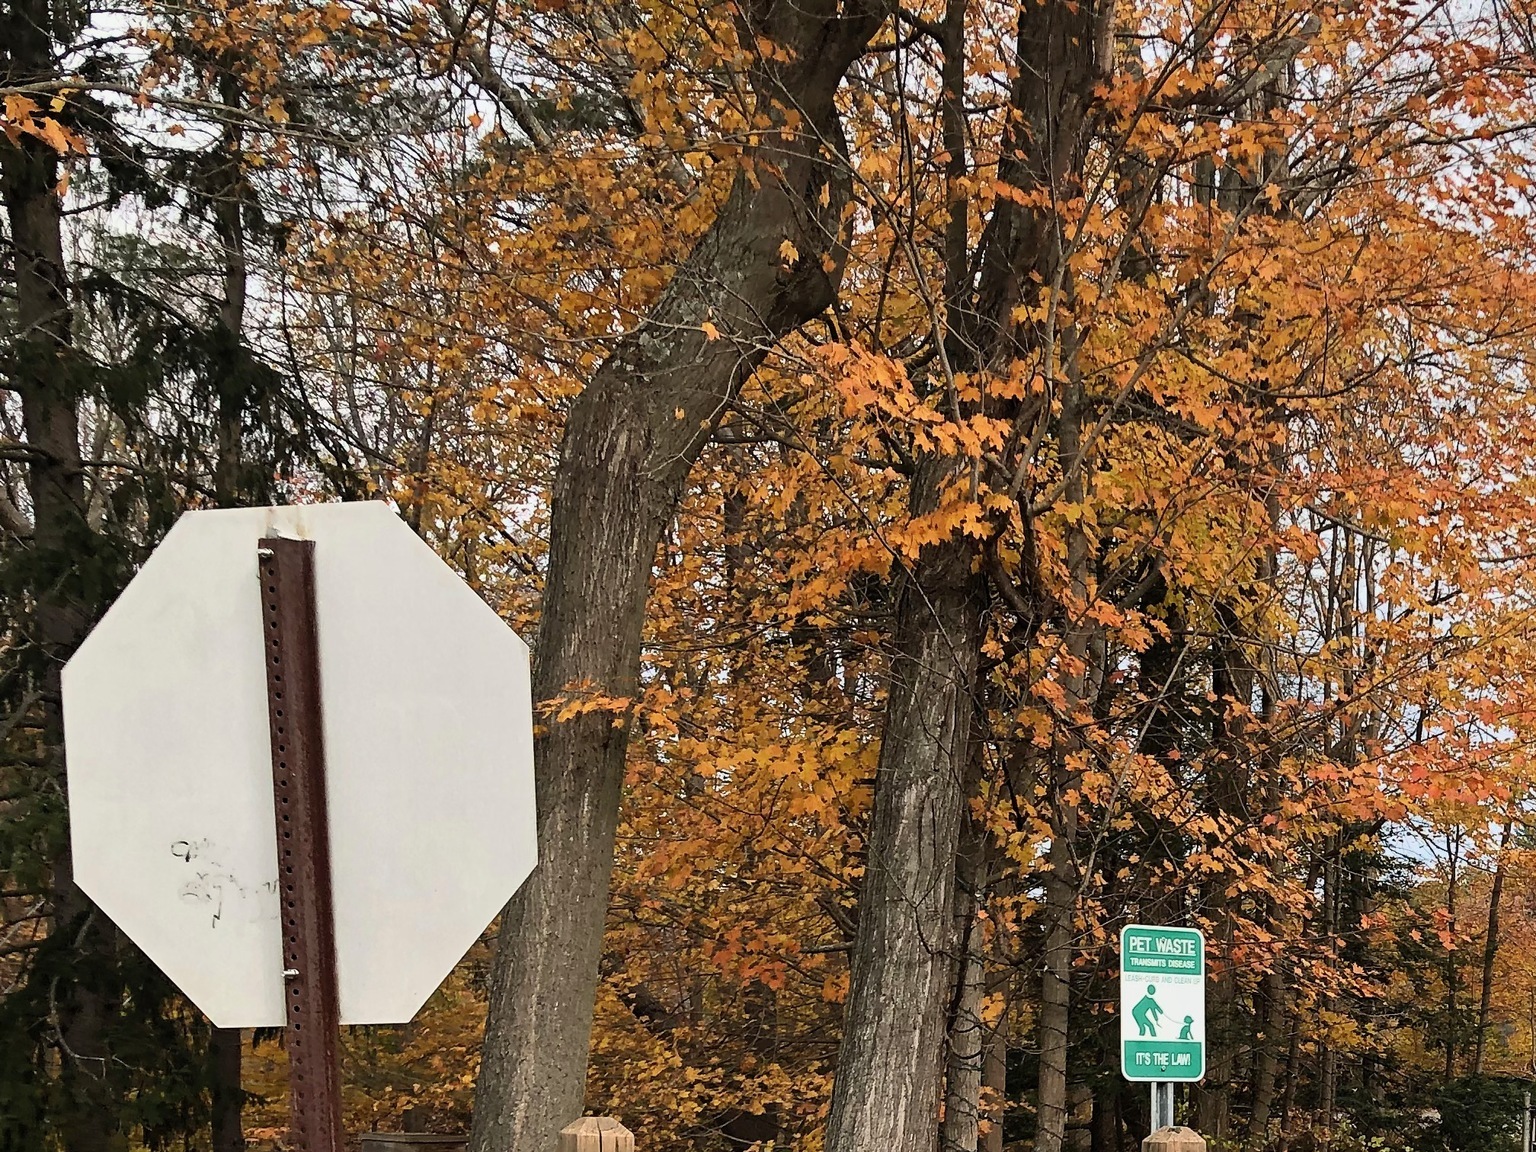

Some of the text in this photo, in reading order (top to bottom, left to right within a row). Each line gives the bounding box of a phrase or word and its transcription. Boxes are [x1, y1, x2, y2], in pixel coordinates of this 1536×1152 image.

[1129, 936, 1196, 955] PET WASTE
[1130, 957, 1196, 969] TRANSMITS DISEASE
[1161, 976, 1173, 984] AND
[1174, 977, 1192, 985] CLEAN
[1135, 1052, 1151, 1066] IT'S
[1152, 1052, 1169, 1066] THE
